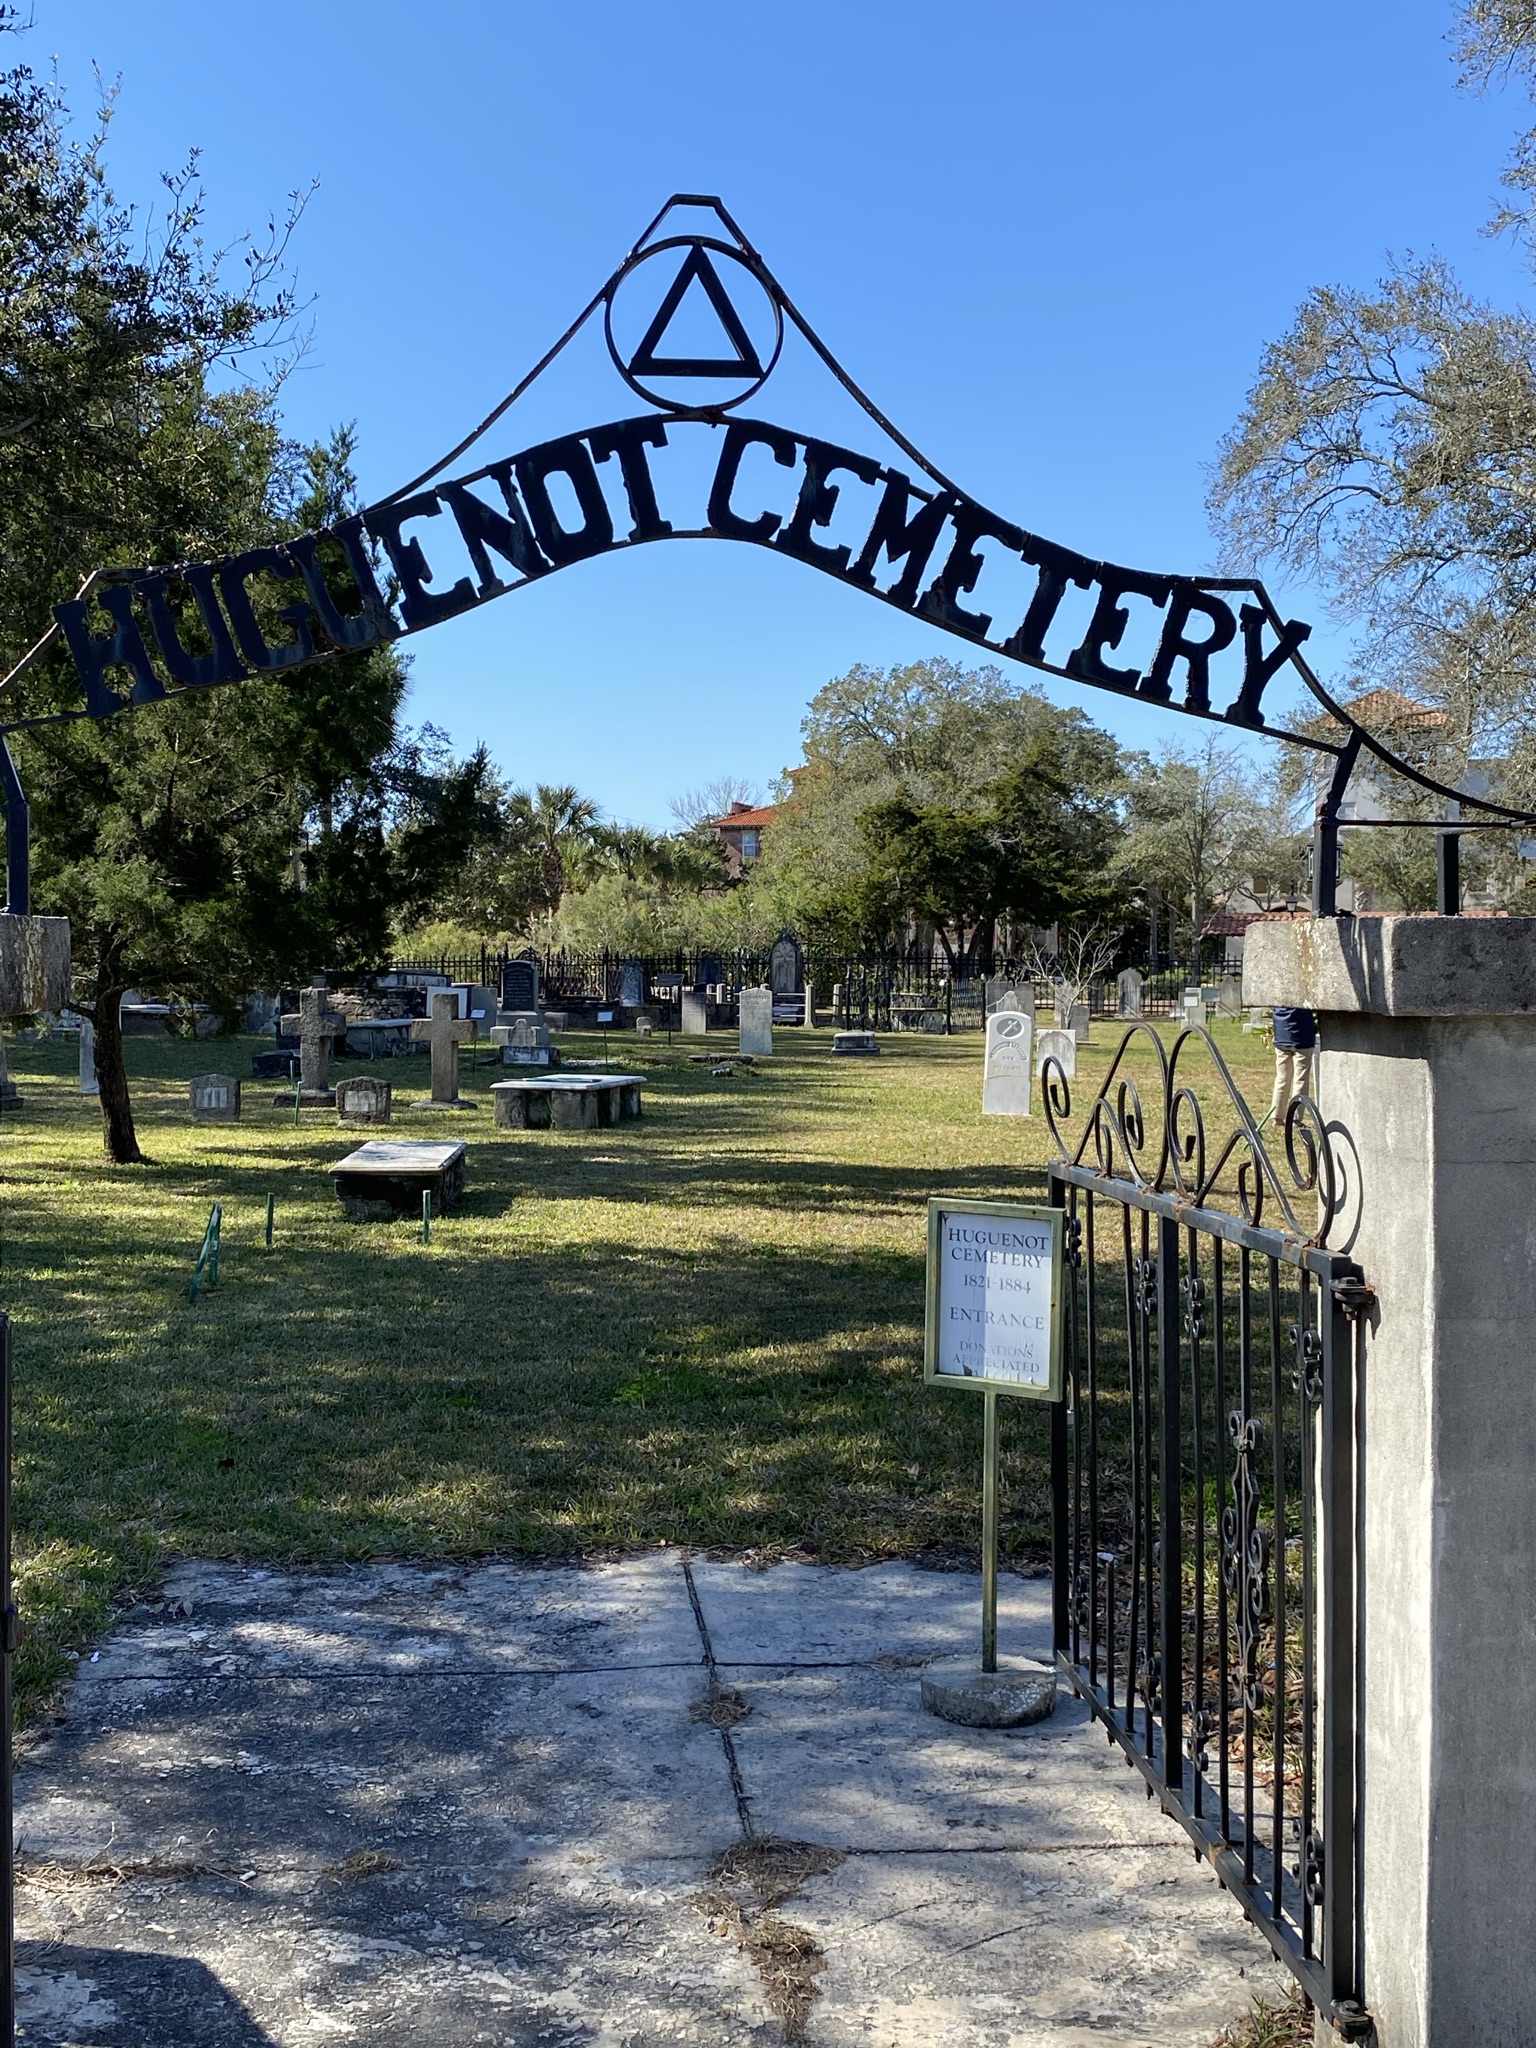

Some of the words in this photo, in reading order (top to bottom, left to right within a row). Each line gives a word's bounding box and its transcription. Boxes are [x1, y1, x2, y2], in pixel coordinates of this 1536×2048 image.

[51, 414, 674, 717] HUGUENOT
[707, 419, 1312, 726] CEMETERY
[948, 1227, 1049, 1251] HUGUENOT
[951, 1247, 1044, 1269] CEMETERY
[963, 1274, 1031, 1294] 1821-1884
[950, 1306, 1045, 1330] ENTRANCE
[960, 1340, 1033, 1359] DONATIONS
